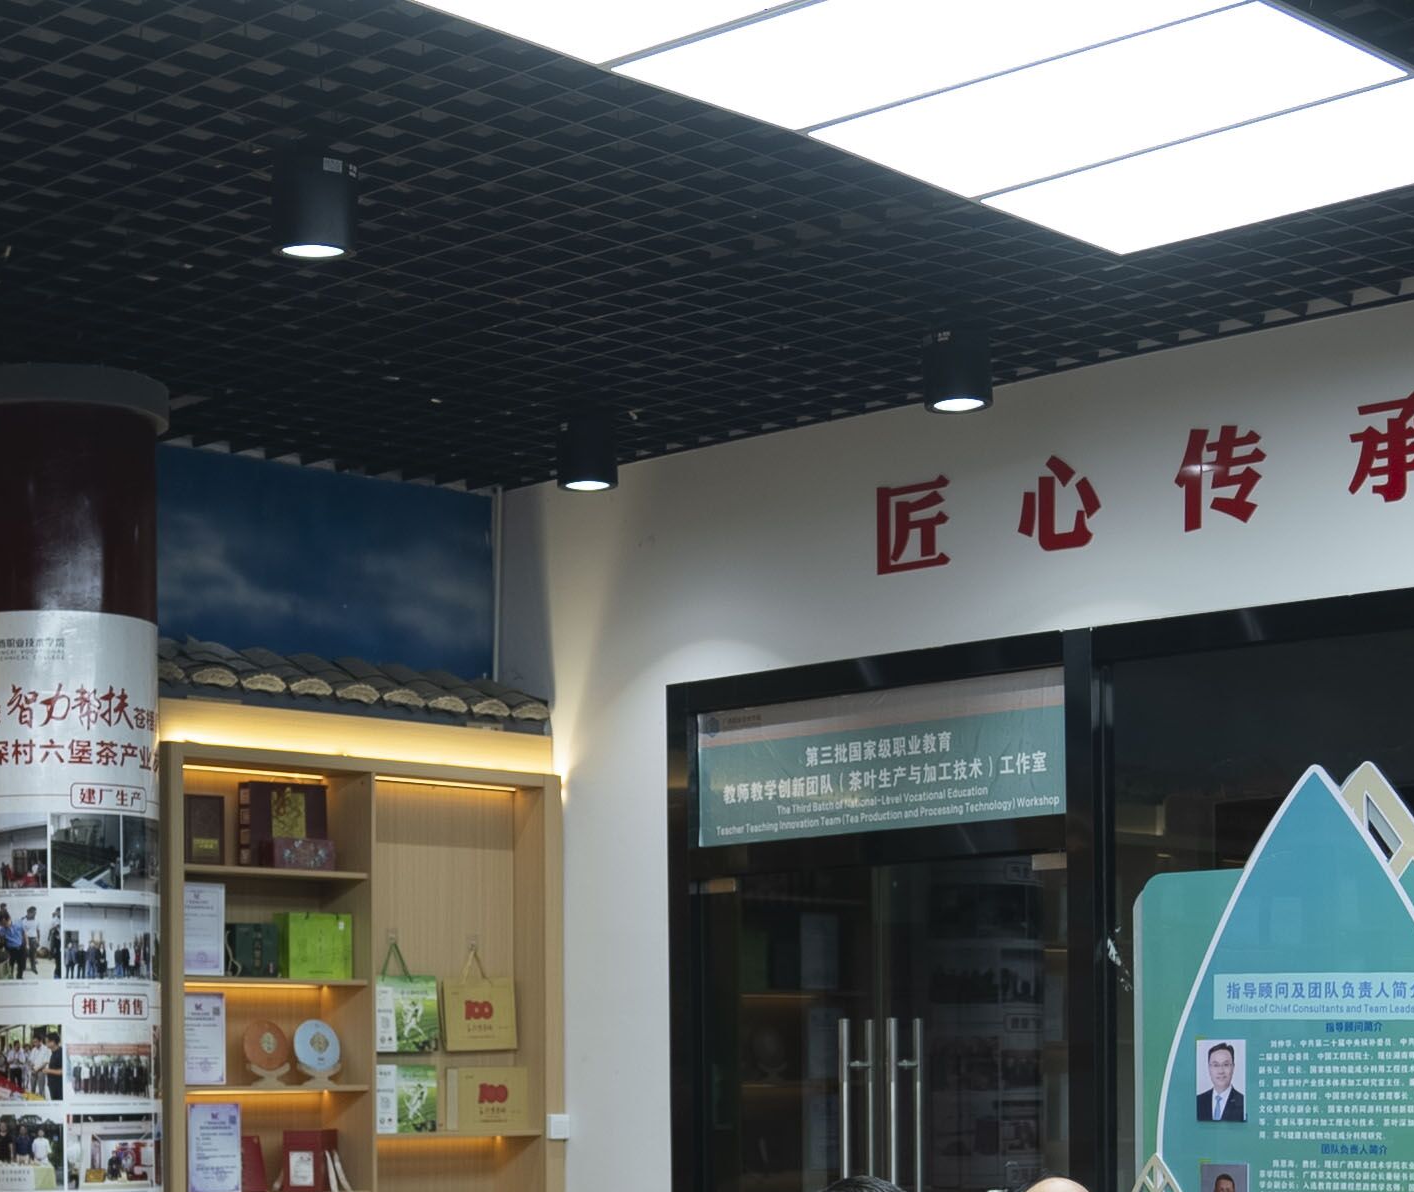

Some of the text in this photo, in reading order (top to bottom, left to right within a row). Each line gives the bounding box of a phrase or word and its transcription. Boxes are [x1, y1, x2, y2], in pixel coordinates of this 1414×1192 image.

[805, 731, 952, 768] 第三批国家级职业教育
[80, 787, 143, 807] 建厂生产
[777, 804, 792, 816] The
[792, 803, 812, 814] Third
[812, 800, 835, 812] Batch
[835, 800, 844, 810] of
[903, 789, 946, 803] Vocational
[947, 785, 988, 799] Education
[716, 825, 745, 836] Teacher
[746, 822, 779, 834] Teaching
[779, 818, 820, 830] Innovation
[820, 815, 842, 826] Team
[860, 810, 903, 822] Production
[904, 807, 919, 818] and
[920, 804, 964, 817] Processing
[965, 798, 1016, 813] Technology)
[1017, 795, 1060, 808] Workshop
[82, 997, 144, 1016] 推广销售
[1226, 1003, 1258, 1013] Profiles
[1258, 1003, 1269, 1013] of
[1269, 1003, 1293, 1014] Chief
[1293, 1003, 1344, 1014] Consultants
[1345, 1004, 1363, 1014] and
[1364, 1004, 1387, 1014] Team
[1325, 1022, 1383, 1033] 指导顾问简介
[1321, 1143, 1388, 1156] 团队负责人简介
